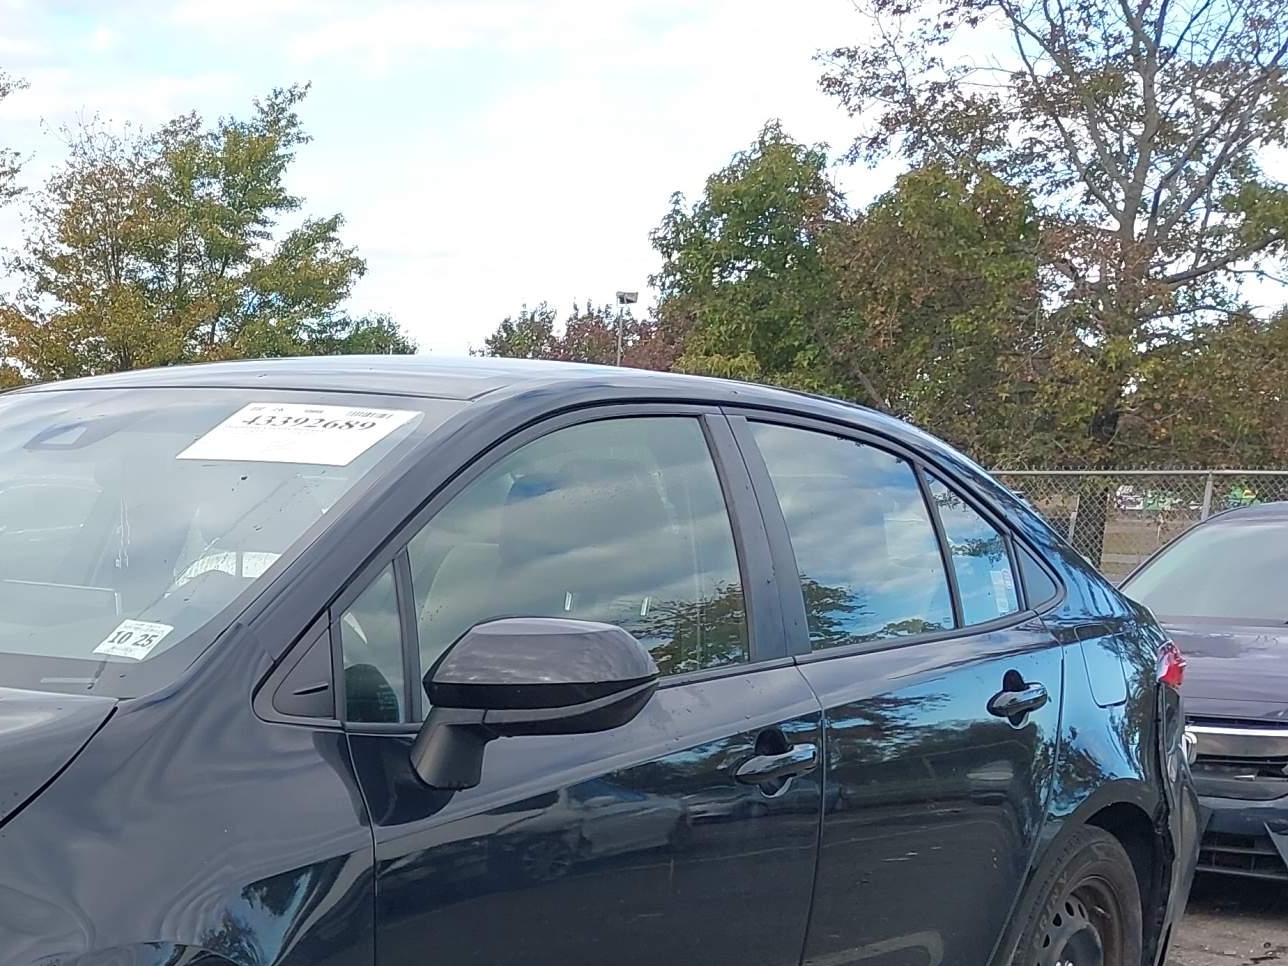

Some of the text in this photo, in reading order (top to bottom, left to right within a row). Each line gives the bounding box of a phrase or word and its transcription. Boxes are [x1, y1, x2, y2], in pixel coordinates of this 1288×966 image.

[241, 415, 377, 431] 43392689
[107, 631, 159, 647] 10 25
